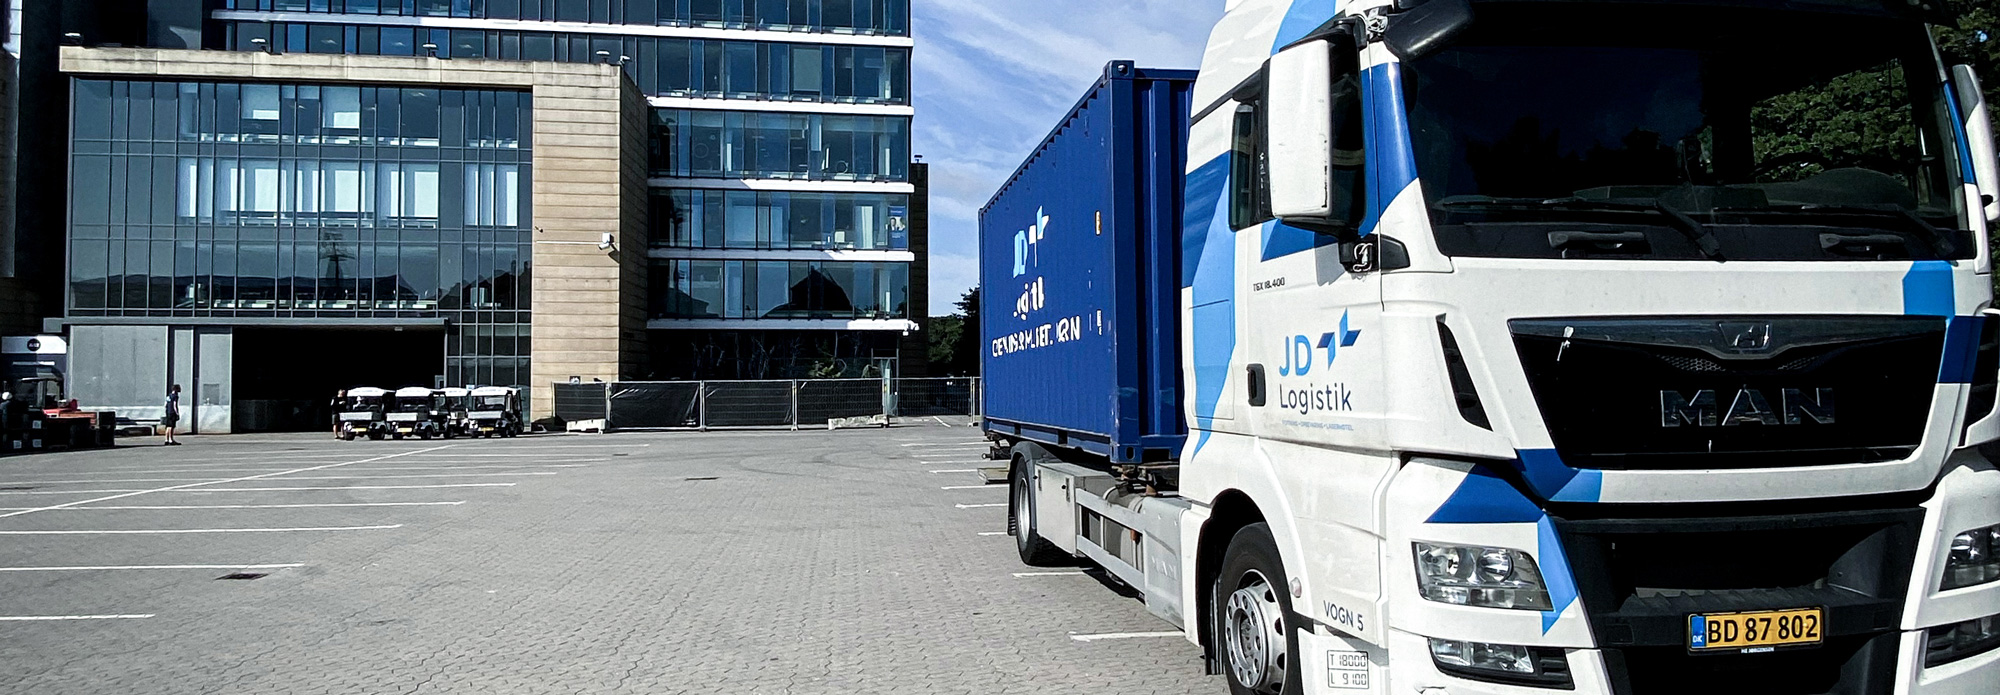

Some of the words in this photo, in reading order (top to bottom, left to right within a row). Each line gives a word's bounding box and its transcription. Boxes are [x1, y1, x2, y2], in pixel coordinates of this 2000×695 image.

[1279, 335, 1312, 377] JD
[1279, 383, 1352, 415] Logistik
[1660, 388, 1835, 427] MAN
[1323, 600, 1354, 628] VOGN
[1357, 613, 1364, 632] 5
[1692, 634, 1703, 643] DK
[1707, 619, 1739, 644] BD
[1745, 617, 1772, 642] 87
[1778, 614, 1818, 640] 802
[1330, 654, 1335, 666] T
[1339, 654, 1367, 667] 18000
[1330, 672, 1335, 685] L
